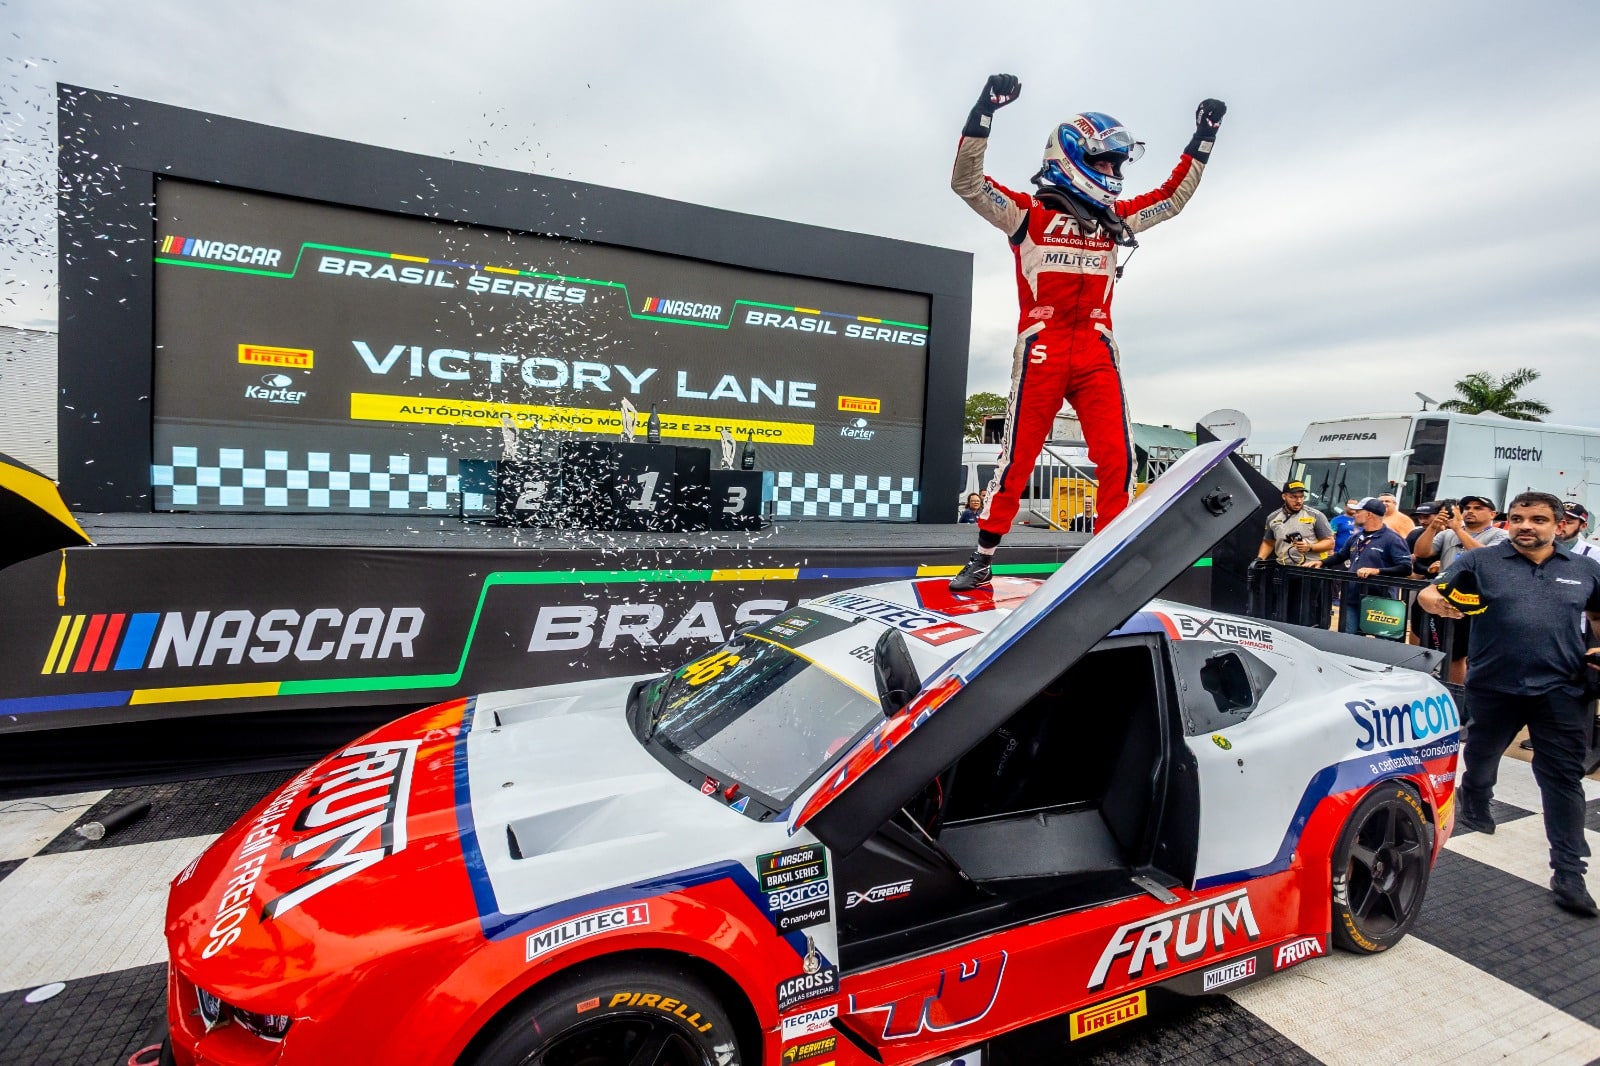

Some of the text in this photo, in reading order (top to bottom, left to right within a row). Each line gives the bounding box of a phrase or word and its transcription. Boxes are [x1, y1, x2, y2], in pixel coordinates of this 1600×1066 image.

[190, 239, 282, 268] NASCAR
[1045, 253, 1101, 267] MILITEC
[317, 256, 586, 304] BRASIL SERIES
[662, 299, 722, 321] NASCAR
[745, 311, 926, 347] BRASIL SERIES
[244, 348, 308, 366] PIRELLI
[352, 340, 817, 408] VICTORY LANE
[244, 385, 307, 401] Karter
[841, 398, 878, 411] PIRELLI
[400, 404, 513, 419] AUTÓDROMO
[517, 412, 593, 425] ORLANDO
[597, 417, 648, 428] MORA
[660, 422, 678, 430] 22
[736, 427, 782, 438] MARÇO
[841, 427, 875, 438] Karter
[1319, 432, 1377, 443] IMPRENSA
[1494, 445, 1543, 462] mastertv
[515, 482, 546, 510] 2
[628, 472, 660, 511] 1
[723, 487, 747, 513] 3
[527, 598, 800, 653] BRAS
[922, 626, 965, 640] 1
[1175, 613, 1273, 644] EXTREME
[1369, 614, 1398, 624] TRUCK
[148, 607, 425, 669] NASCAR
[1239, 639, 1274, 651] SIMRACING
[1344, 693, 1459, 752] Simcon
[239, 823, 281, 861] EM
[272, 738, 423, 920] FRUM
[781, 850, 814, 867] NASCAR
[767, 866, 820, 887] BRASIL SERIES
[201, 853, 267, 960] FREIOS
[768, 882, 828, 910] sparco
[845, 879, 914, 909] EXTREME
[533, 907, 643, 953] MILITEC 1
[790, 909, 826, 924] nano4you
[1087, 888, 1260, 989] FRUM
[1343, 913, 1378, 951] PIRELLI
[1276, 937, 1323, 968] FRUM
[779, 970, 833, 1001] ACROSS
[1206, 960, 1253, 987] MILITEC 1
[806, 985, 834, 998] ESPECIAIS
[608, 992, 713, 1033] PIRELLI
[784, 1007, 835, 1029] TECPADS
[806, 1021, 831, 1032] Racin
[1077, 995, 1140, 1035] PIRELLI
[799, 1037, 836, 1055] SERVITEC
